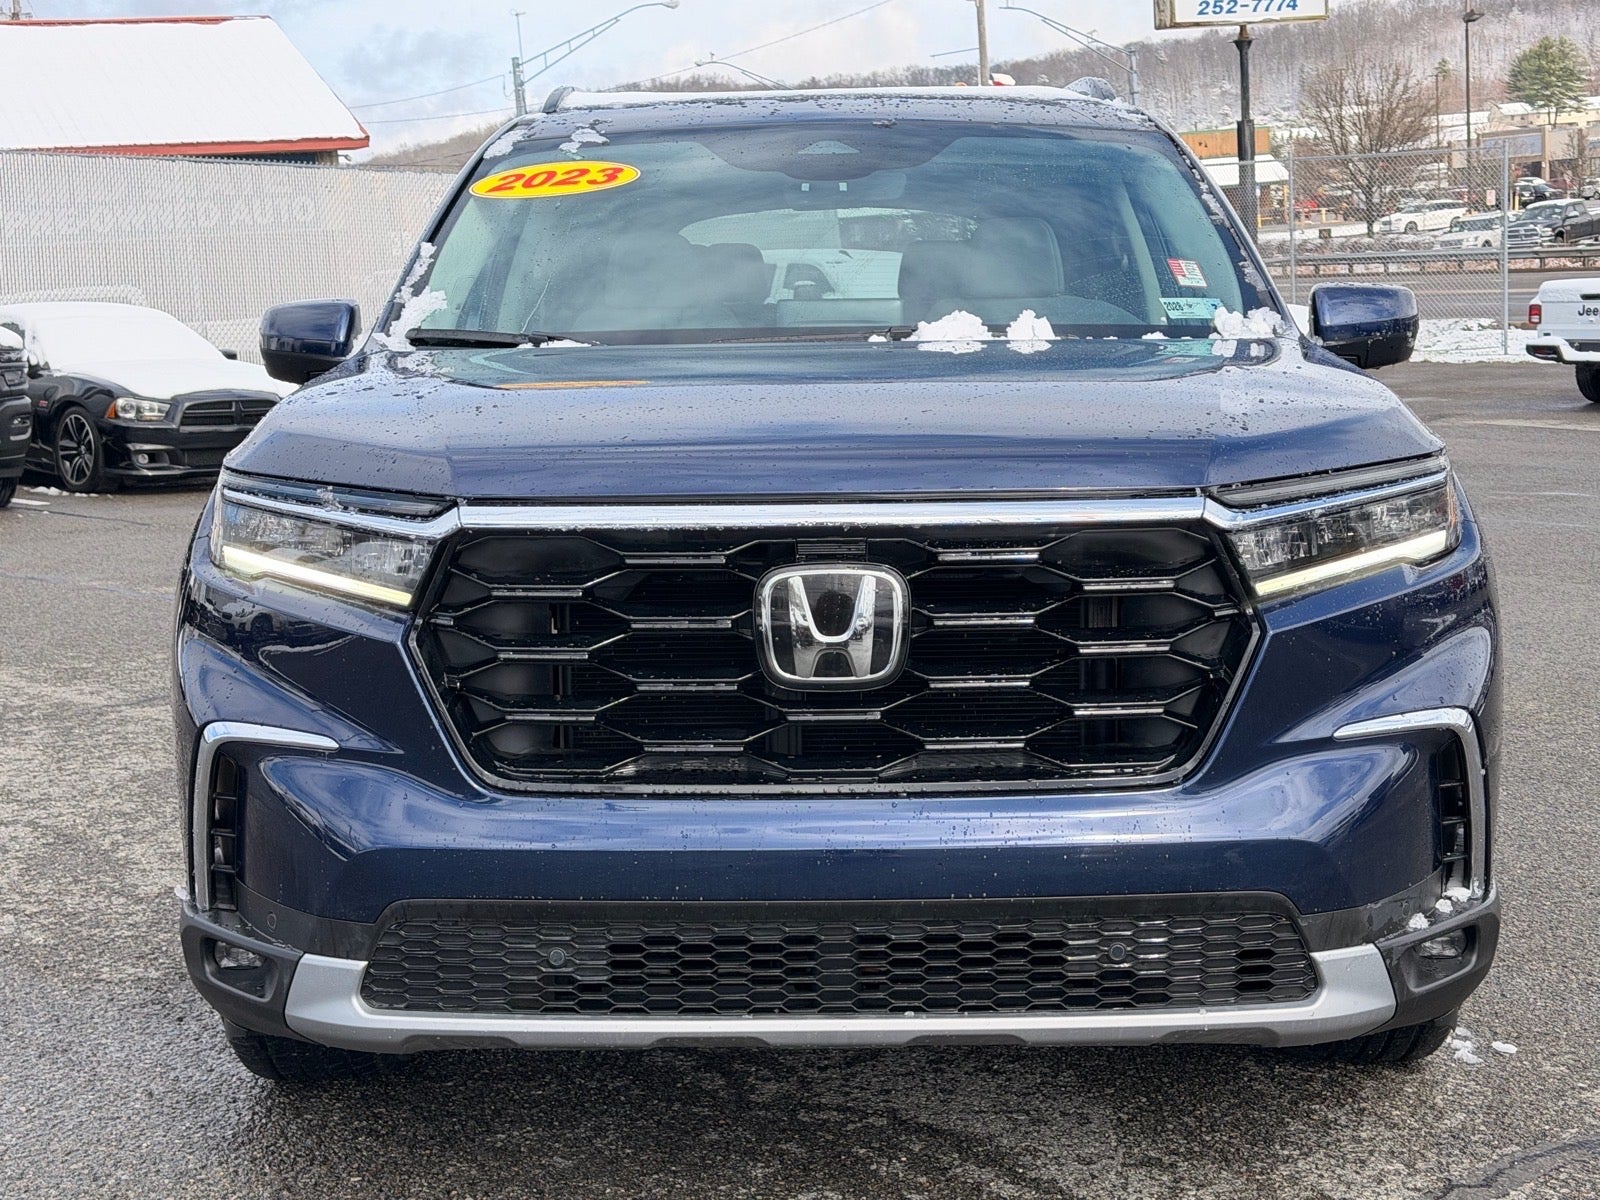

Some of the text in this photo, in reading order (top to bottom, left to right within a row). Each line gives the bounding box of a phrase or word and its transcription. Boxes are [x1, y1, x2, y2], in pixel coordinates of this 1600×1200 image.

[1197, 0, 1298, 15] 252-7774
[485, 167, 625, 193] 2023
[230, 195, 316, 227] AUTO
[1577, 304, 1600, 317] Jee
